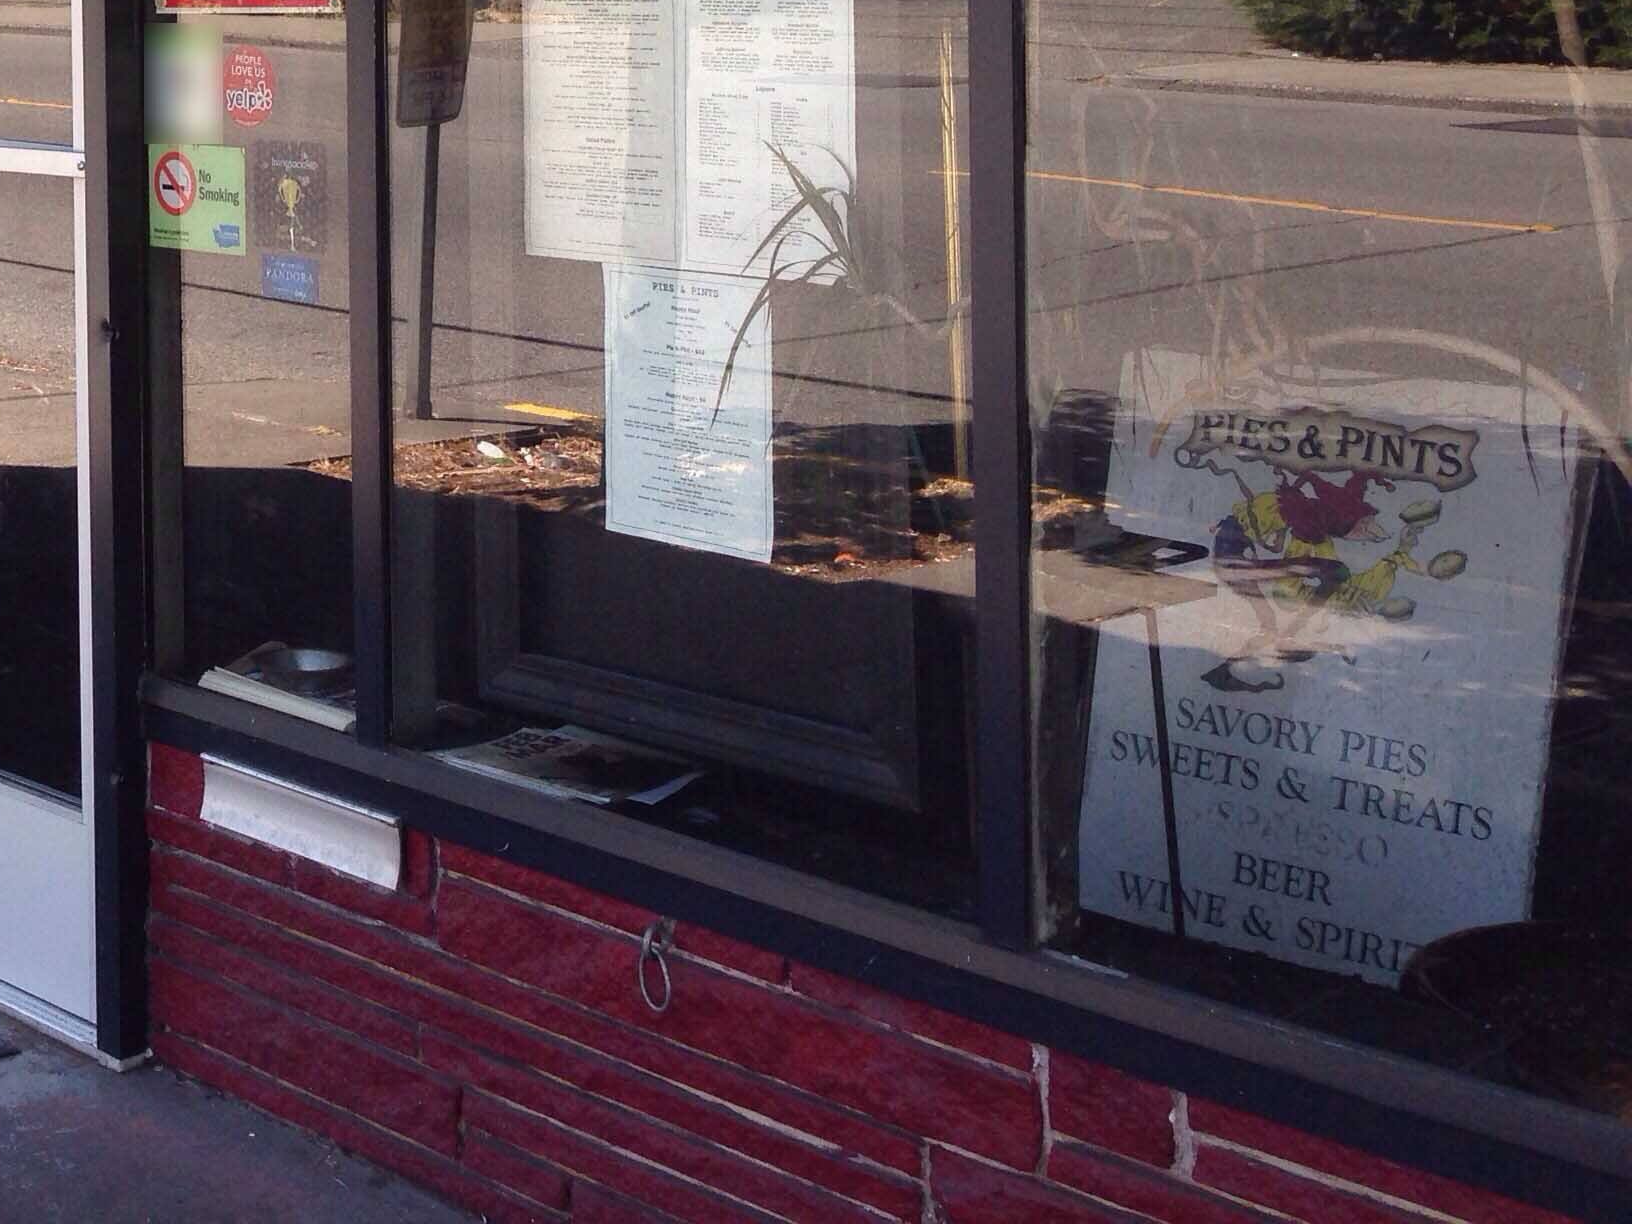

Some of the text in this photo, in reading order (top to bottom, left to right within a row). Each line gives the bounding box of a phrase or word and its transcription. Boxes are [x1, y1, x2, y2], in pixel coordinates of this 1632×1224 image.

[231, 65, 266, 78] LOVE US
[234, 53, 262, 66] PEOPLE
[226, 89, 258, 112] yelp
[199, 169, 211, 184] No
[199, 186, 240, 207] Smoking
[1201, 414, 1464, 478] PIES & PINTS
[1176, 697, 1428, 777] SAVORY PIES
[1111, 730, 1261, 791] SWEETS
[1276, 766, 1309, 803] &
[1330, 775, 1494, 841] TREATS
[1232, 851, 1333, 906] BEER
[1115, 870, 1226, 928] WINE
[1243, 904, 1277, 942] &
